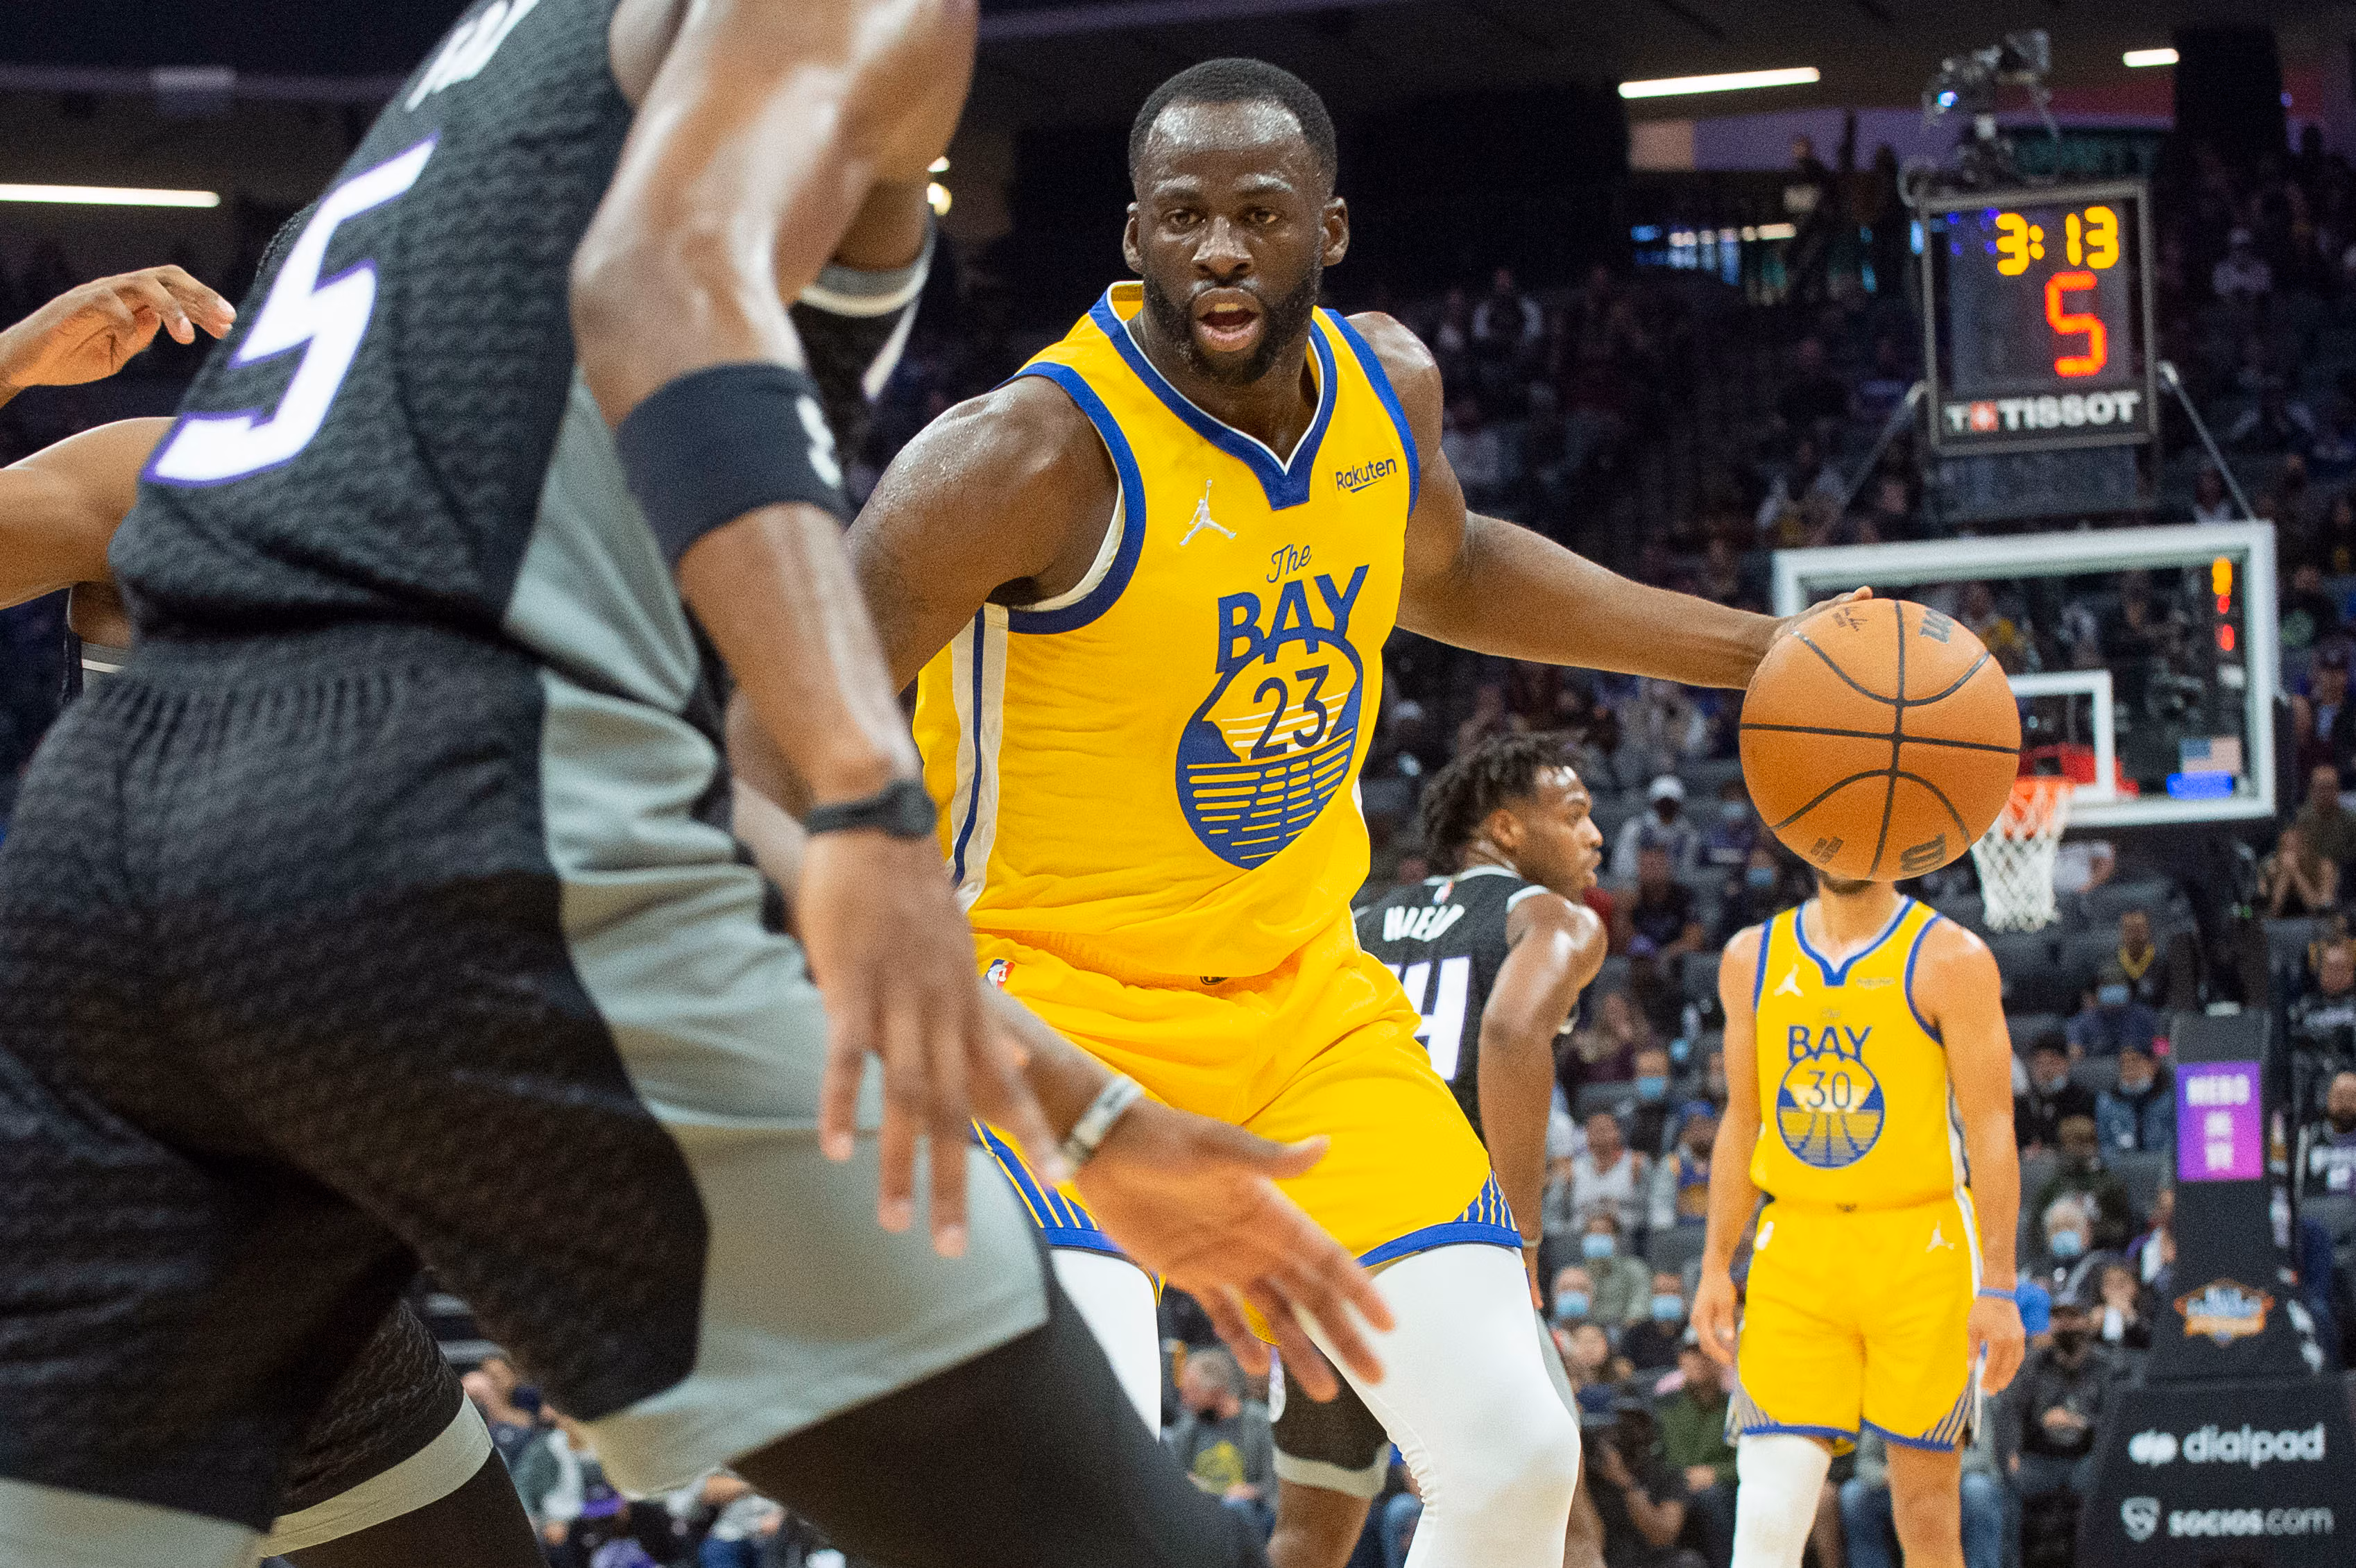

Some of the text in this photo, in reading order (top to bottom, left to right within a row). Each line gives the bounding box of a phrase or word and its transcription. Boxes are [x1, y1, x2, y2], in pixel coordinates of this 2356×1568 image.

[1996, 206, 2119, 275] 3:13
[142, 130, 441, 486] 5
[2045, 271, 2108, 377] 5
[1335, 458, 1397, 491] Rakuten
[1266, 543, 1312, 583] The
[1215, 564, 1370, 674] BAY
[1250, 664, 1331, 760] 23
[1788, 1025, 1872, 1065] BAY
[1807, 1071, 1852, 1109] 30
[2183, 1422, 2325, 1469] dialpad
